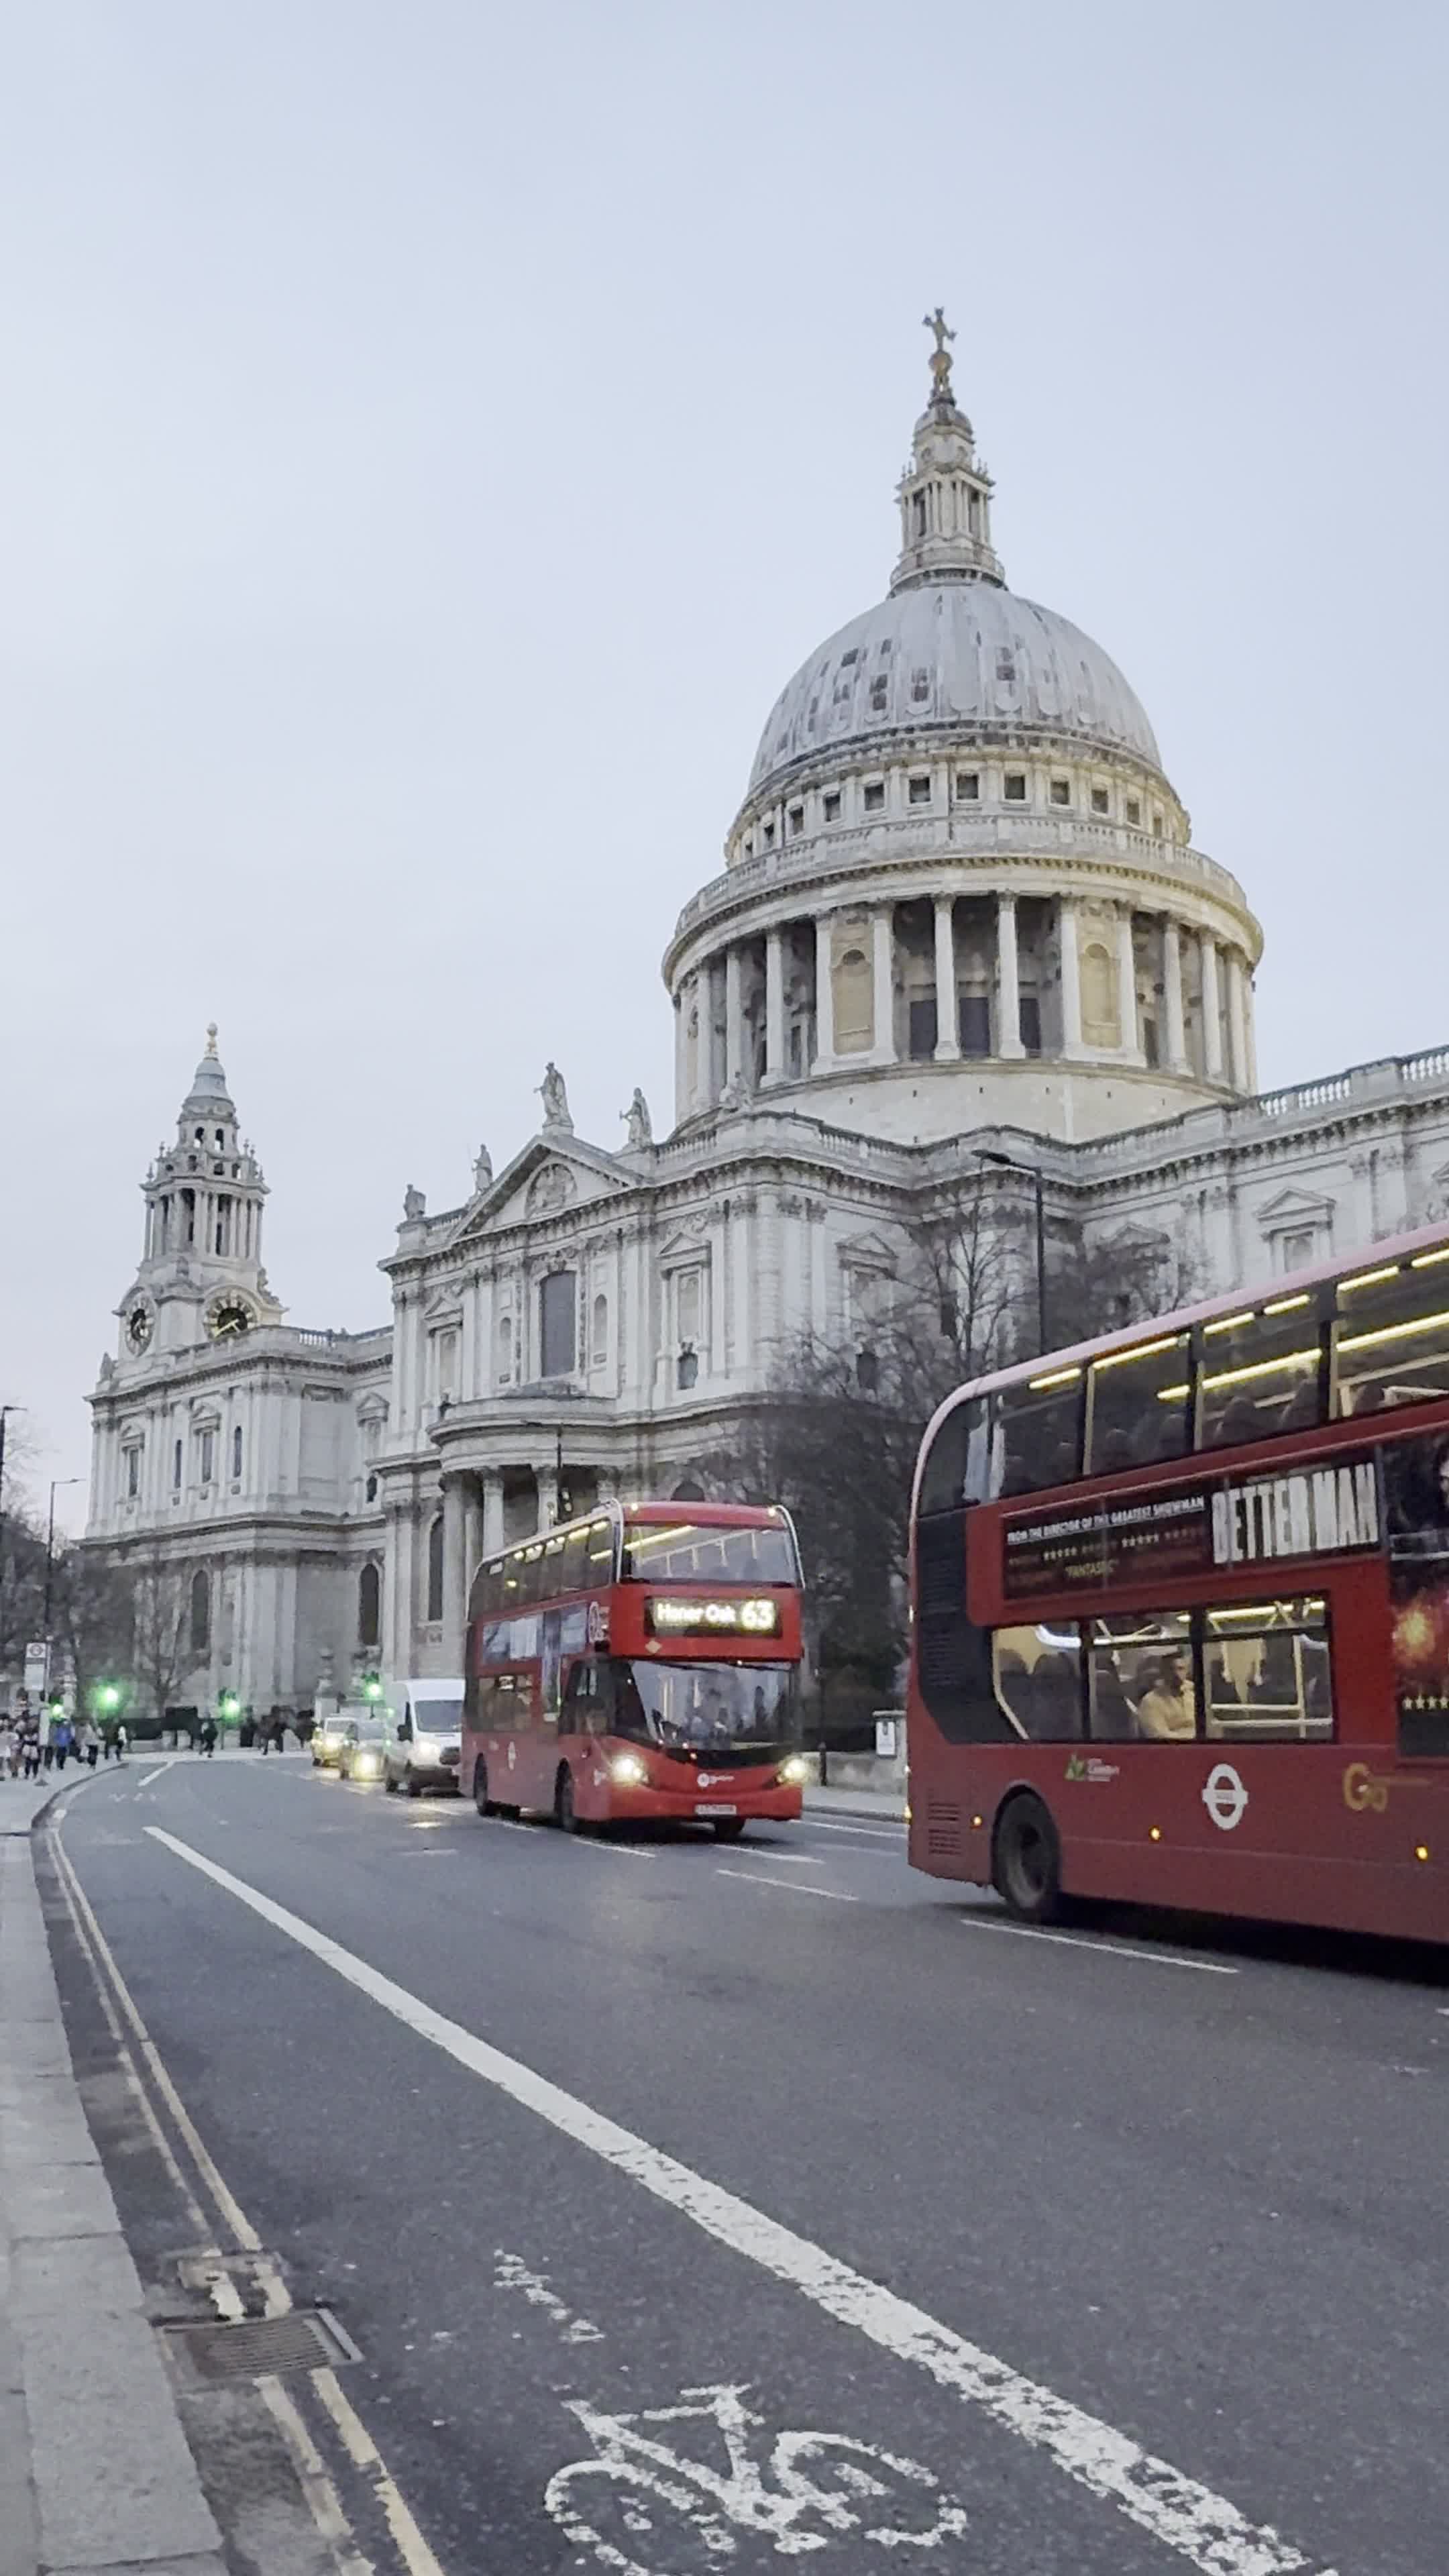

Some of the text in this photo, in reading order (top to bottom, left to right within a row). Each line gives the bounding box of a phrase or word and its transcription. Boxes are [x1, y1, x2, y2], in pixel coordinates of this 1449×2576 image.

[1153, 1495, 1205, 1517] SHOWMAN
[1212, 1462, 1379, 1564] BETTER MAN
[704, 1603, 737, 1623] Oak
[740, 1600, 775, 1631] 63
